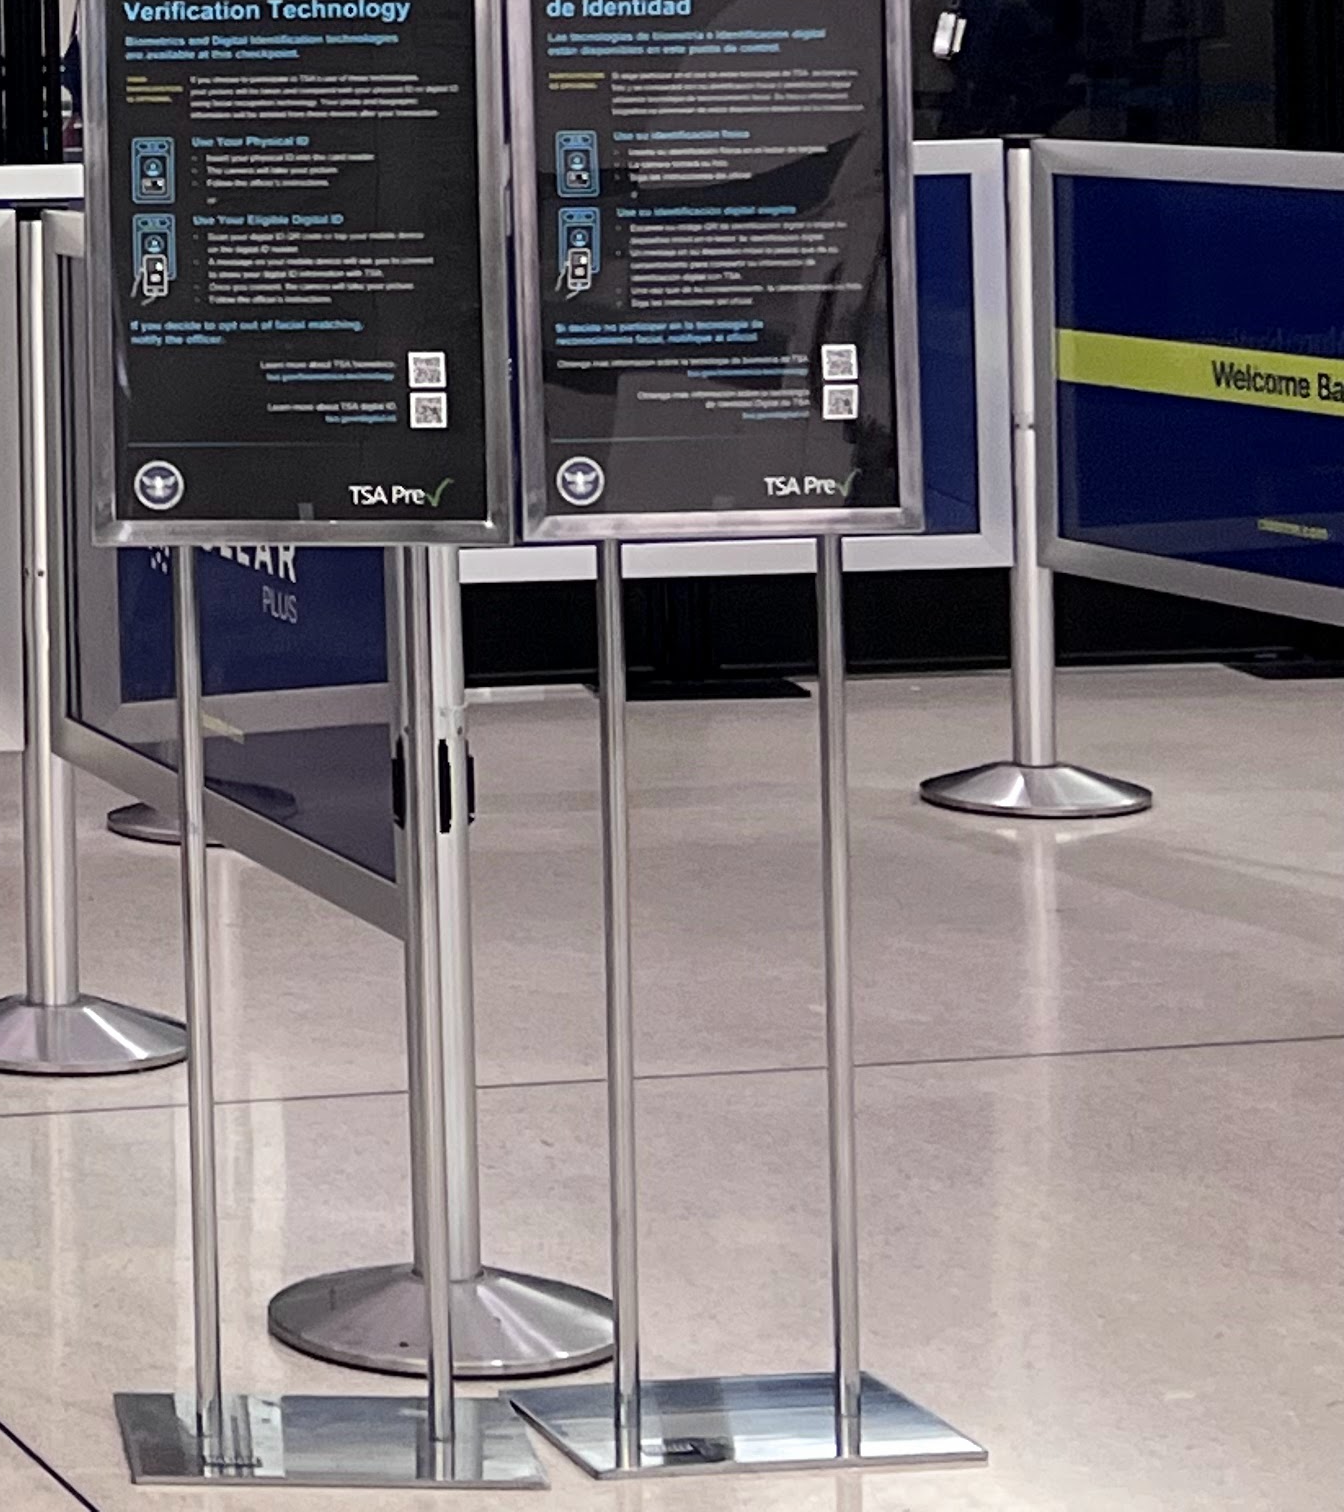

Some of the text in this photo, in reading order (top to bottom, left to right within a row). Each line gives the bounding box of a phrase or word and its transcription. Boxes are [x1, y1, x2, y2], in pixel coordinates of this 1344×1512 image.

[123, 0, 261, 22] Verification
[1211, 359, 1344, 403] Welcome Ba
[348, 485, 426, 505] TSA Pre
[764, 475, 836, 497] TSA Pre
[261, 584, 299, 625] PLUS
